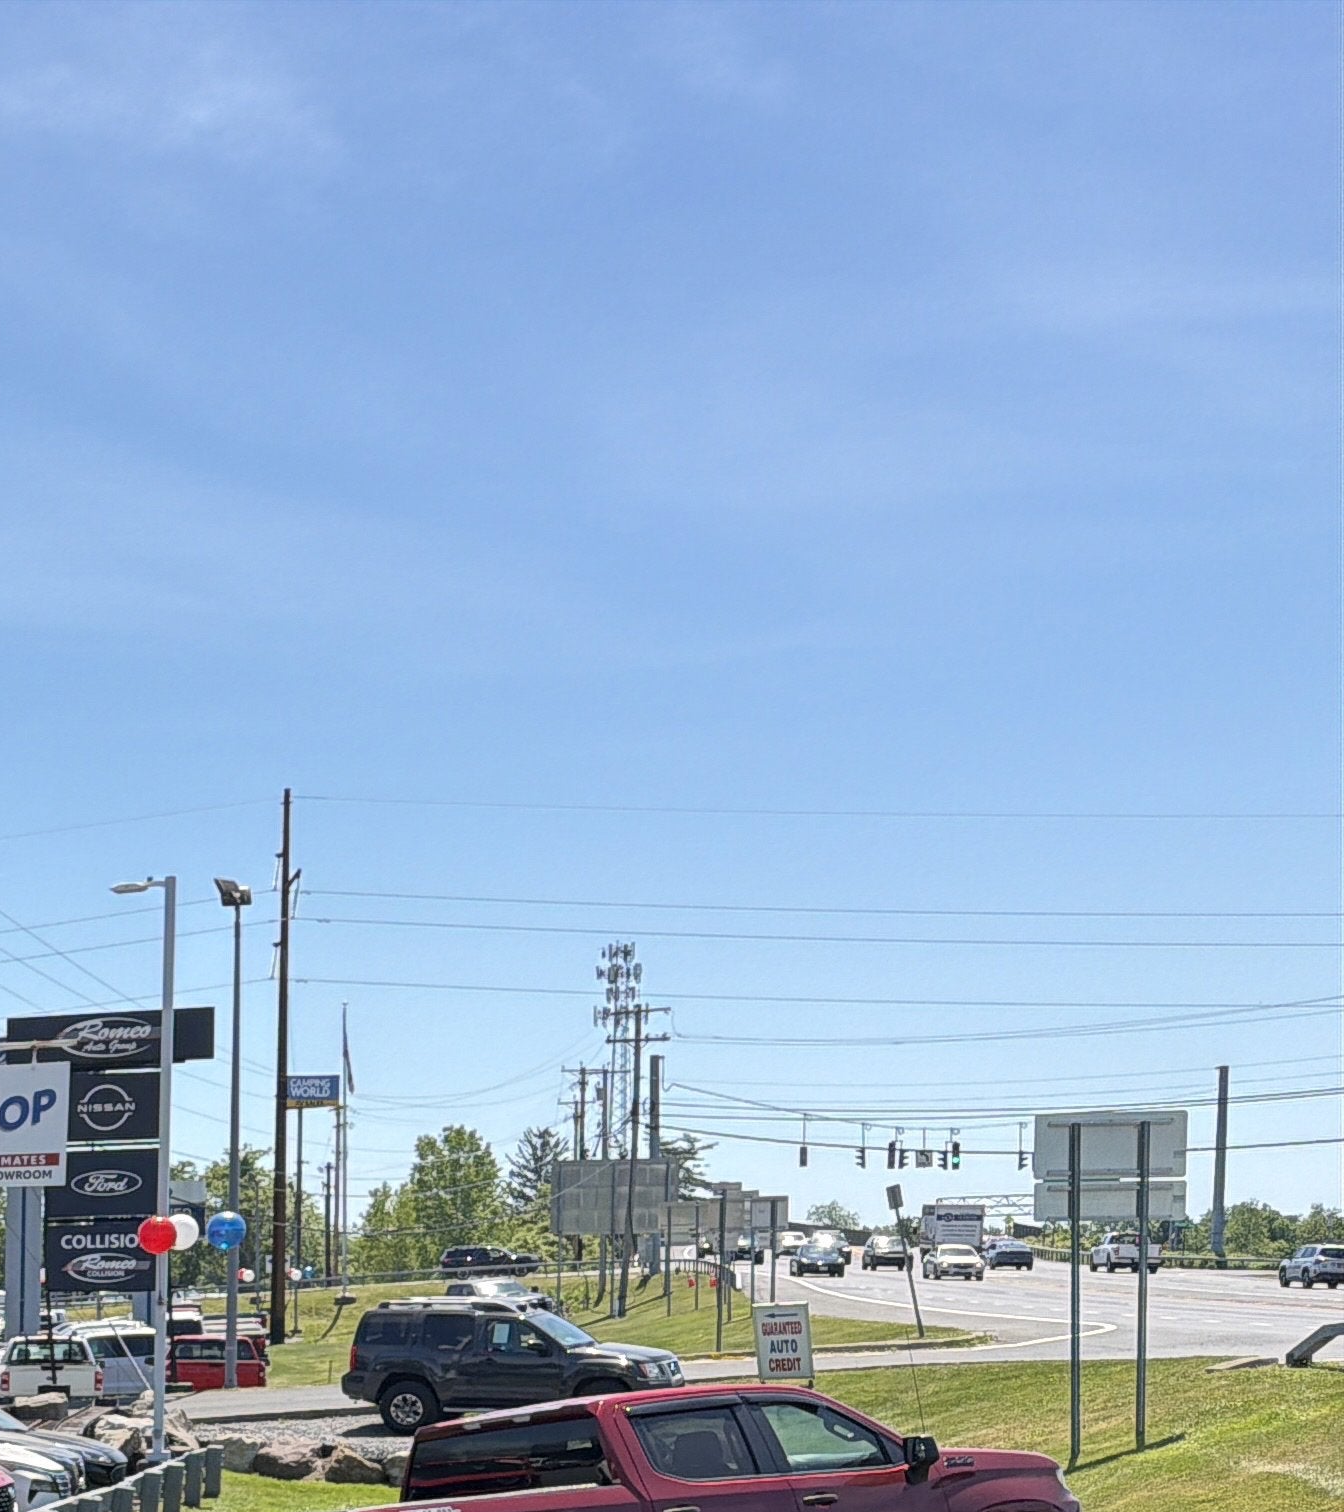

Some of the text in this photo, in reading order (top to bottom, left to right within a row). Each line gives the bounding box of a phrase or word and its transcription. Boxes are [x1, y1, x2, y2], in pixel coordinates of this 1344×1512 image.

[77, 1018, 152, 1042] Romeo
[290, 1086, 331, 1098] WORLD
[77, 1101, 136, 1113] NISSAN
[83, 1173, 129, 1192] Ford
[60, 1233, 140, 1250] COLLISIO
[80, 1254, 137, 1271] Romeo
[86, 1269, 126, 1277] COLLISION
[761, 1321, 803, 1337] GUARANTEED
[769, 1338, 799, 1354] AUTO
[768, 1356, 802, 1373] CREDIT
